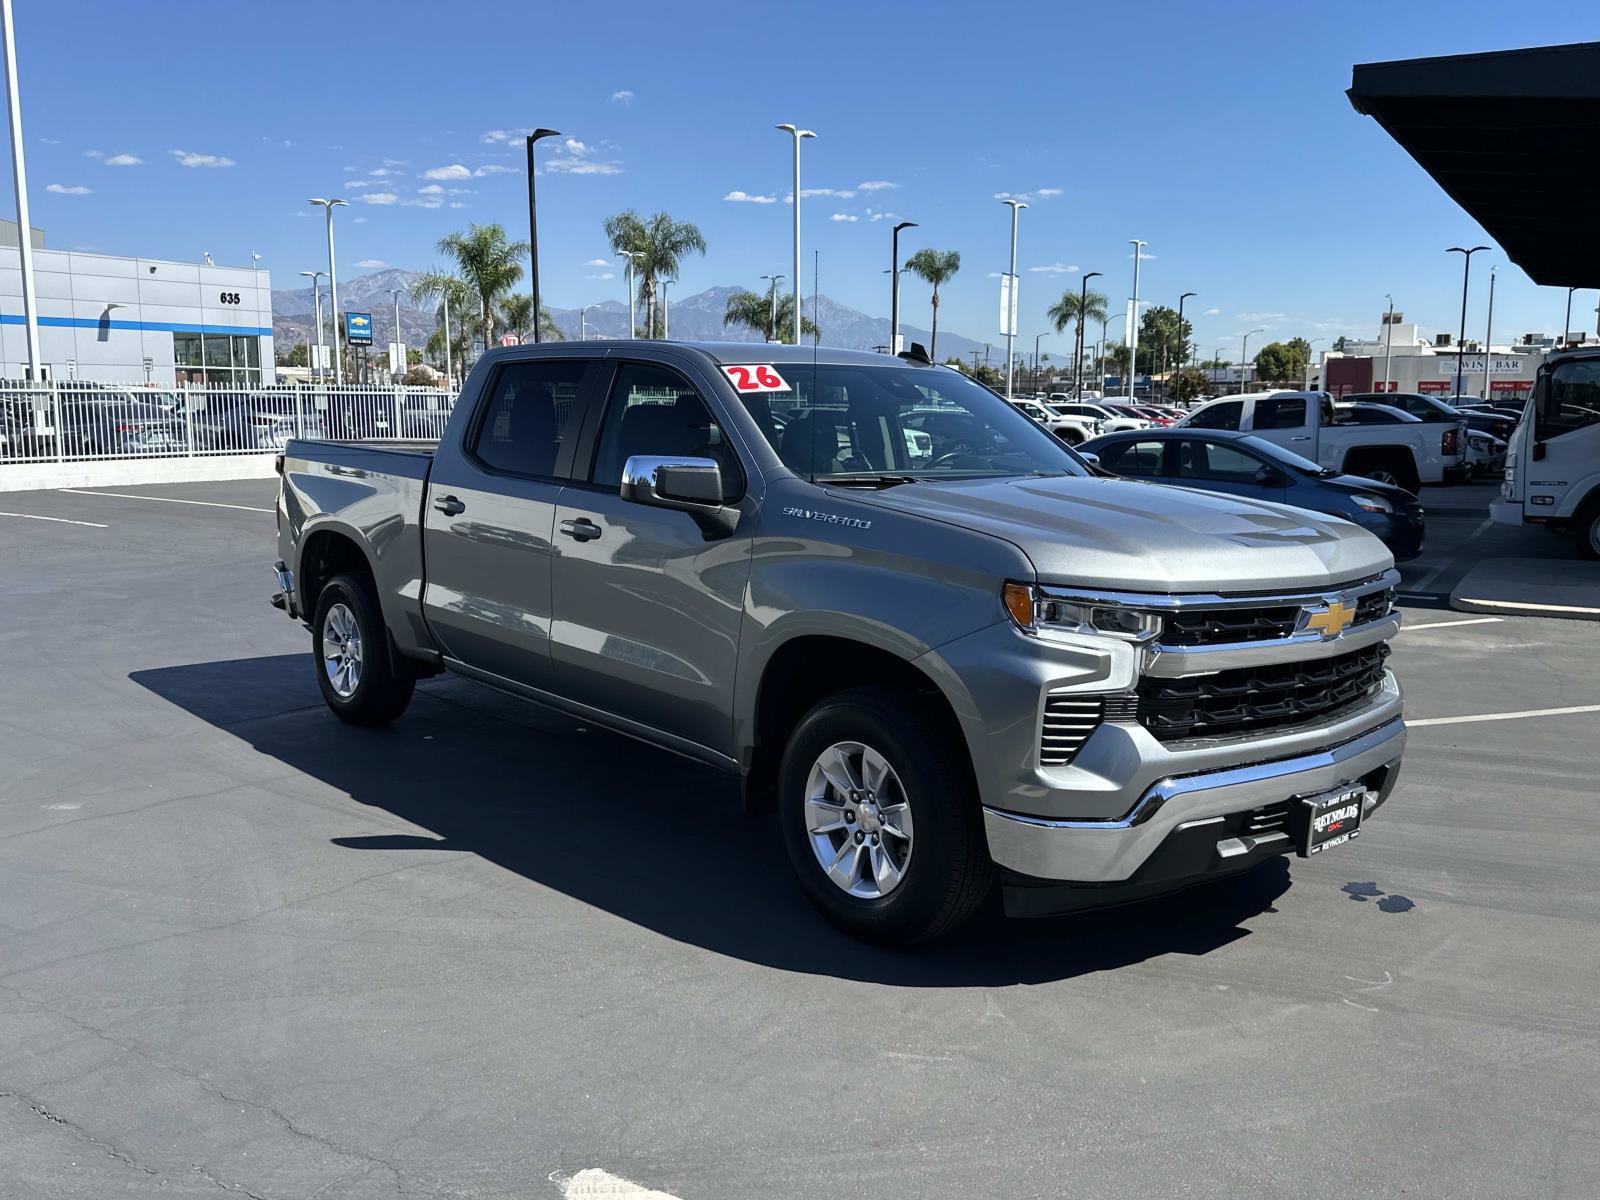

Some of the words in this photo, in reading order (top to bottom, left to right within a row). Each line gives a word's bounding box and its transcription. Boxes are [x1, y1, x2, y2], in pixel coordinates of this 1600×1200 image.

[219, 291, 241, 305] 635
[1460, 361, 1491, 369] WIN
[1495, 361, 1519, 369] BAR
[727, 365, 781, 390] 26
[782, 506, 872, 529] SILVERADO
[1313, 803, 1359, 833] REYNOLDS
[1327, 820, 1345, 832] GMC
[1321, 834, 1349, 851] REYNOLDS
